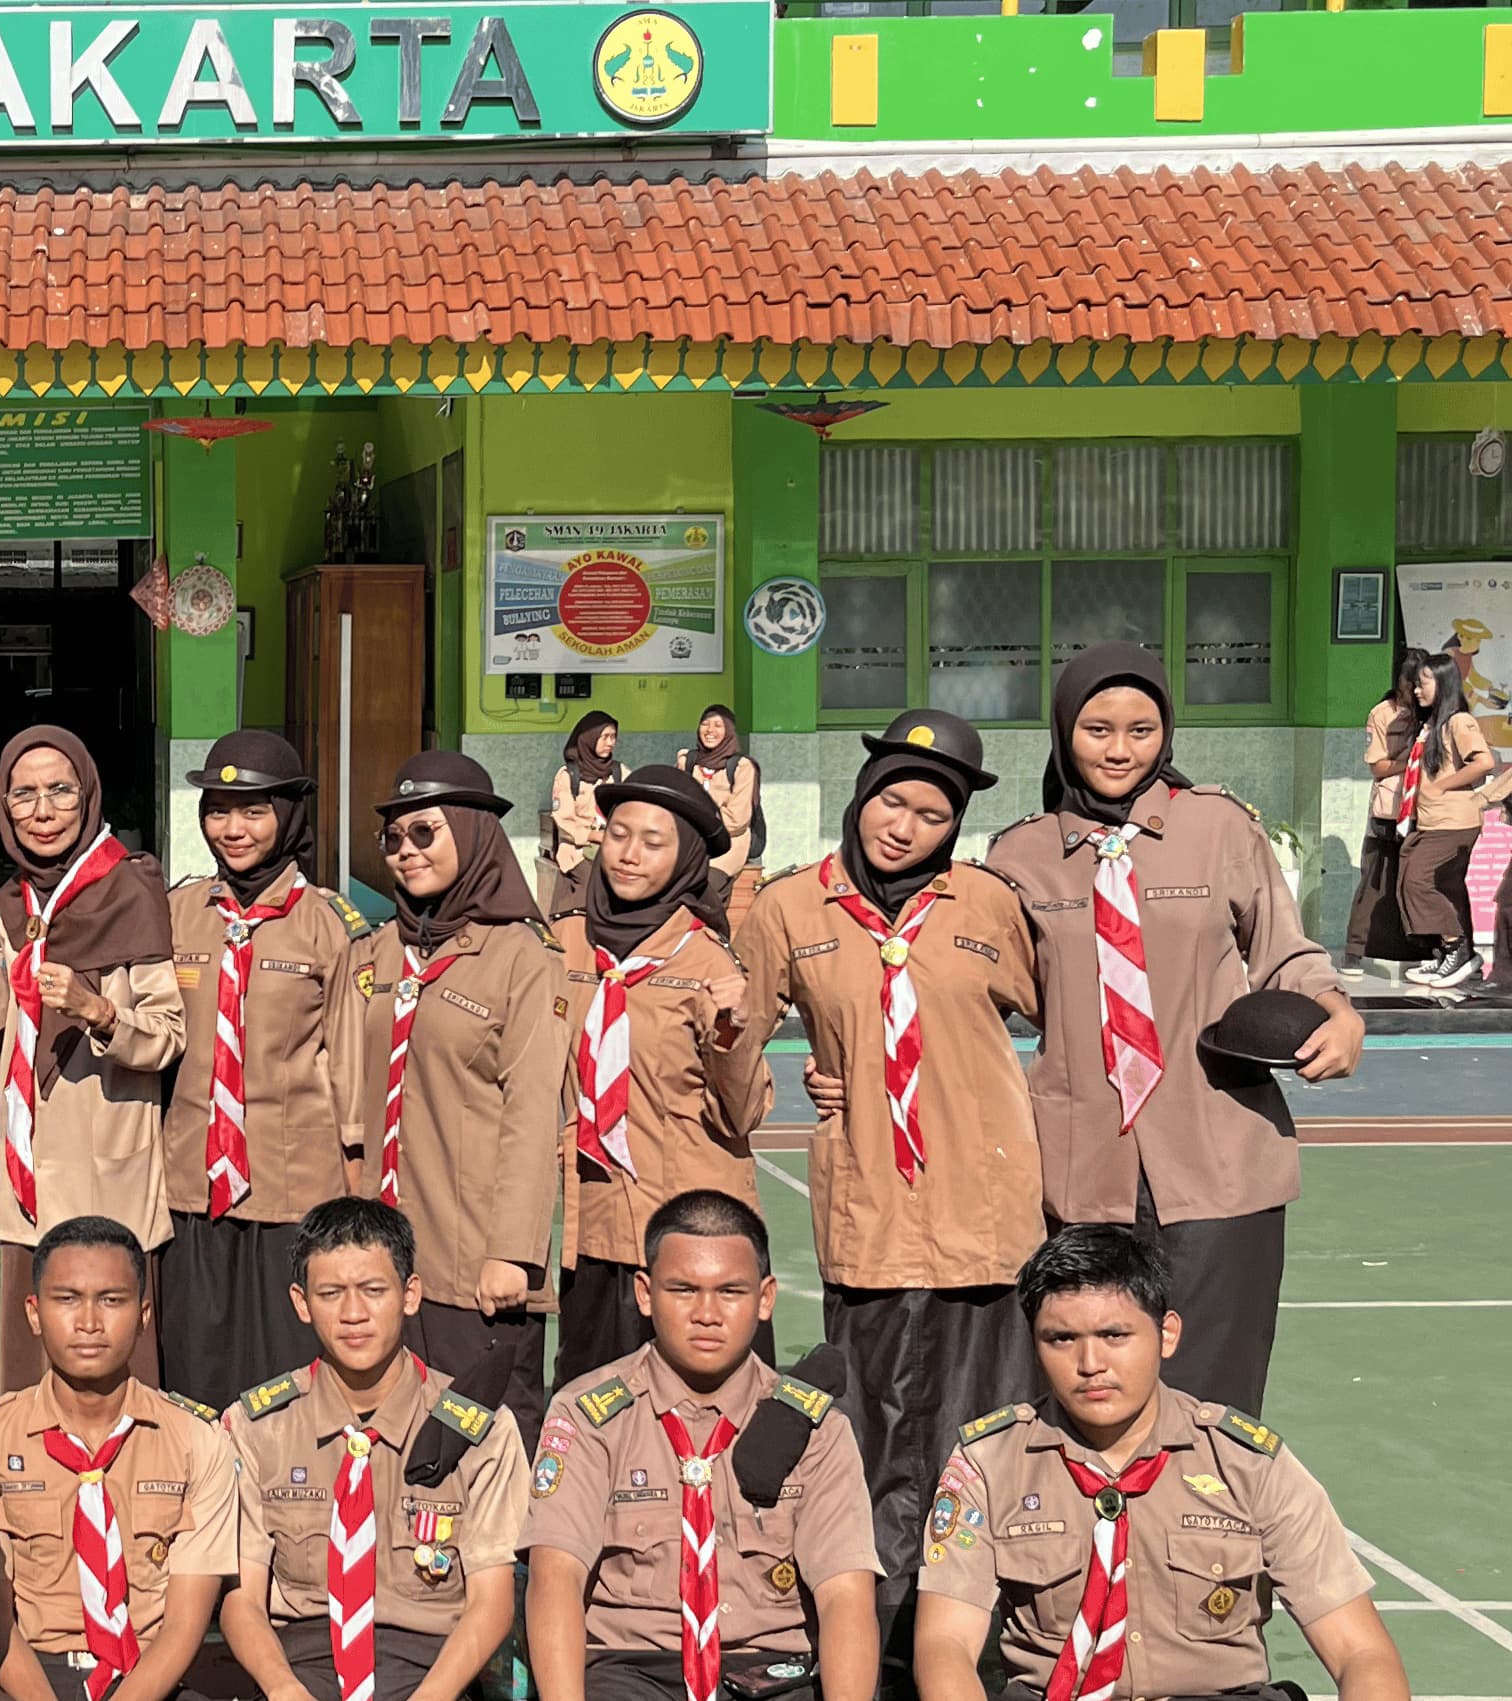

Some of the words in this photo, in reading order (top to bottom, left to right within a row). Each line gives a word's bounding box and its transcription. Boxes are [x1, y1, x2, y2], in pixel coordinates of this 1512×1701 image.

[545, 525, 581, 536] SMAN
[610, 525, 667, 536] JAKARTA
[567, 554, 592, 572] AYO
[596, 550, 643, 572] KAWAL
[499, 588, 555, 601] PELECEHAN
[655, 587, 713, 600] PEMERASAN
[503, 609, 551, 625] BULLYING
[559, 631, 613, 657] SEKOLAH
[616, 630, 649, 654] AMAN
[404, 1500, 458, 1513] GTOTKACA
[1020, 1523, 1051, 1533] RAGIL
